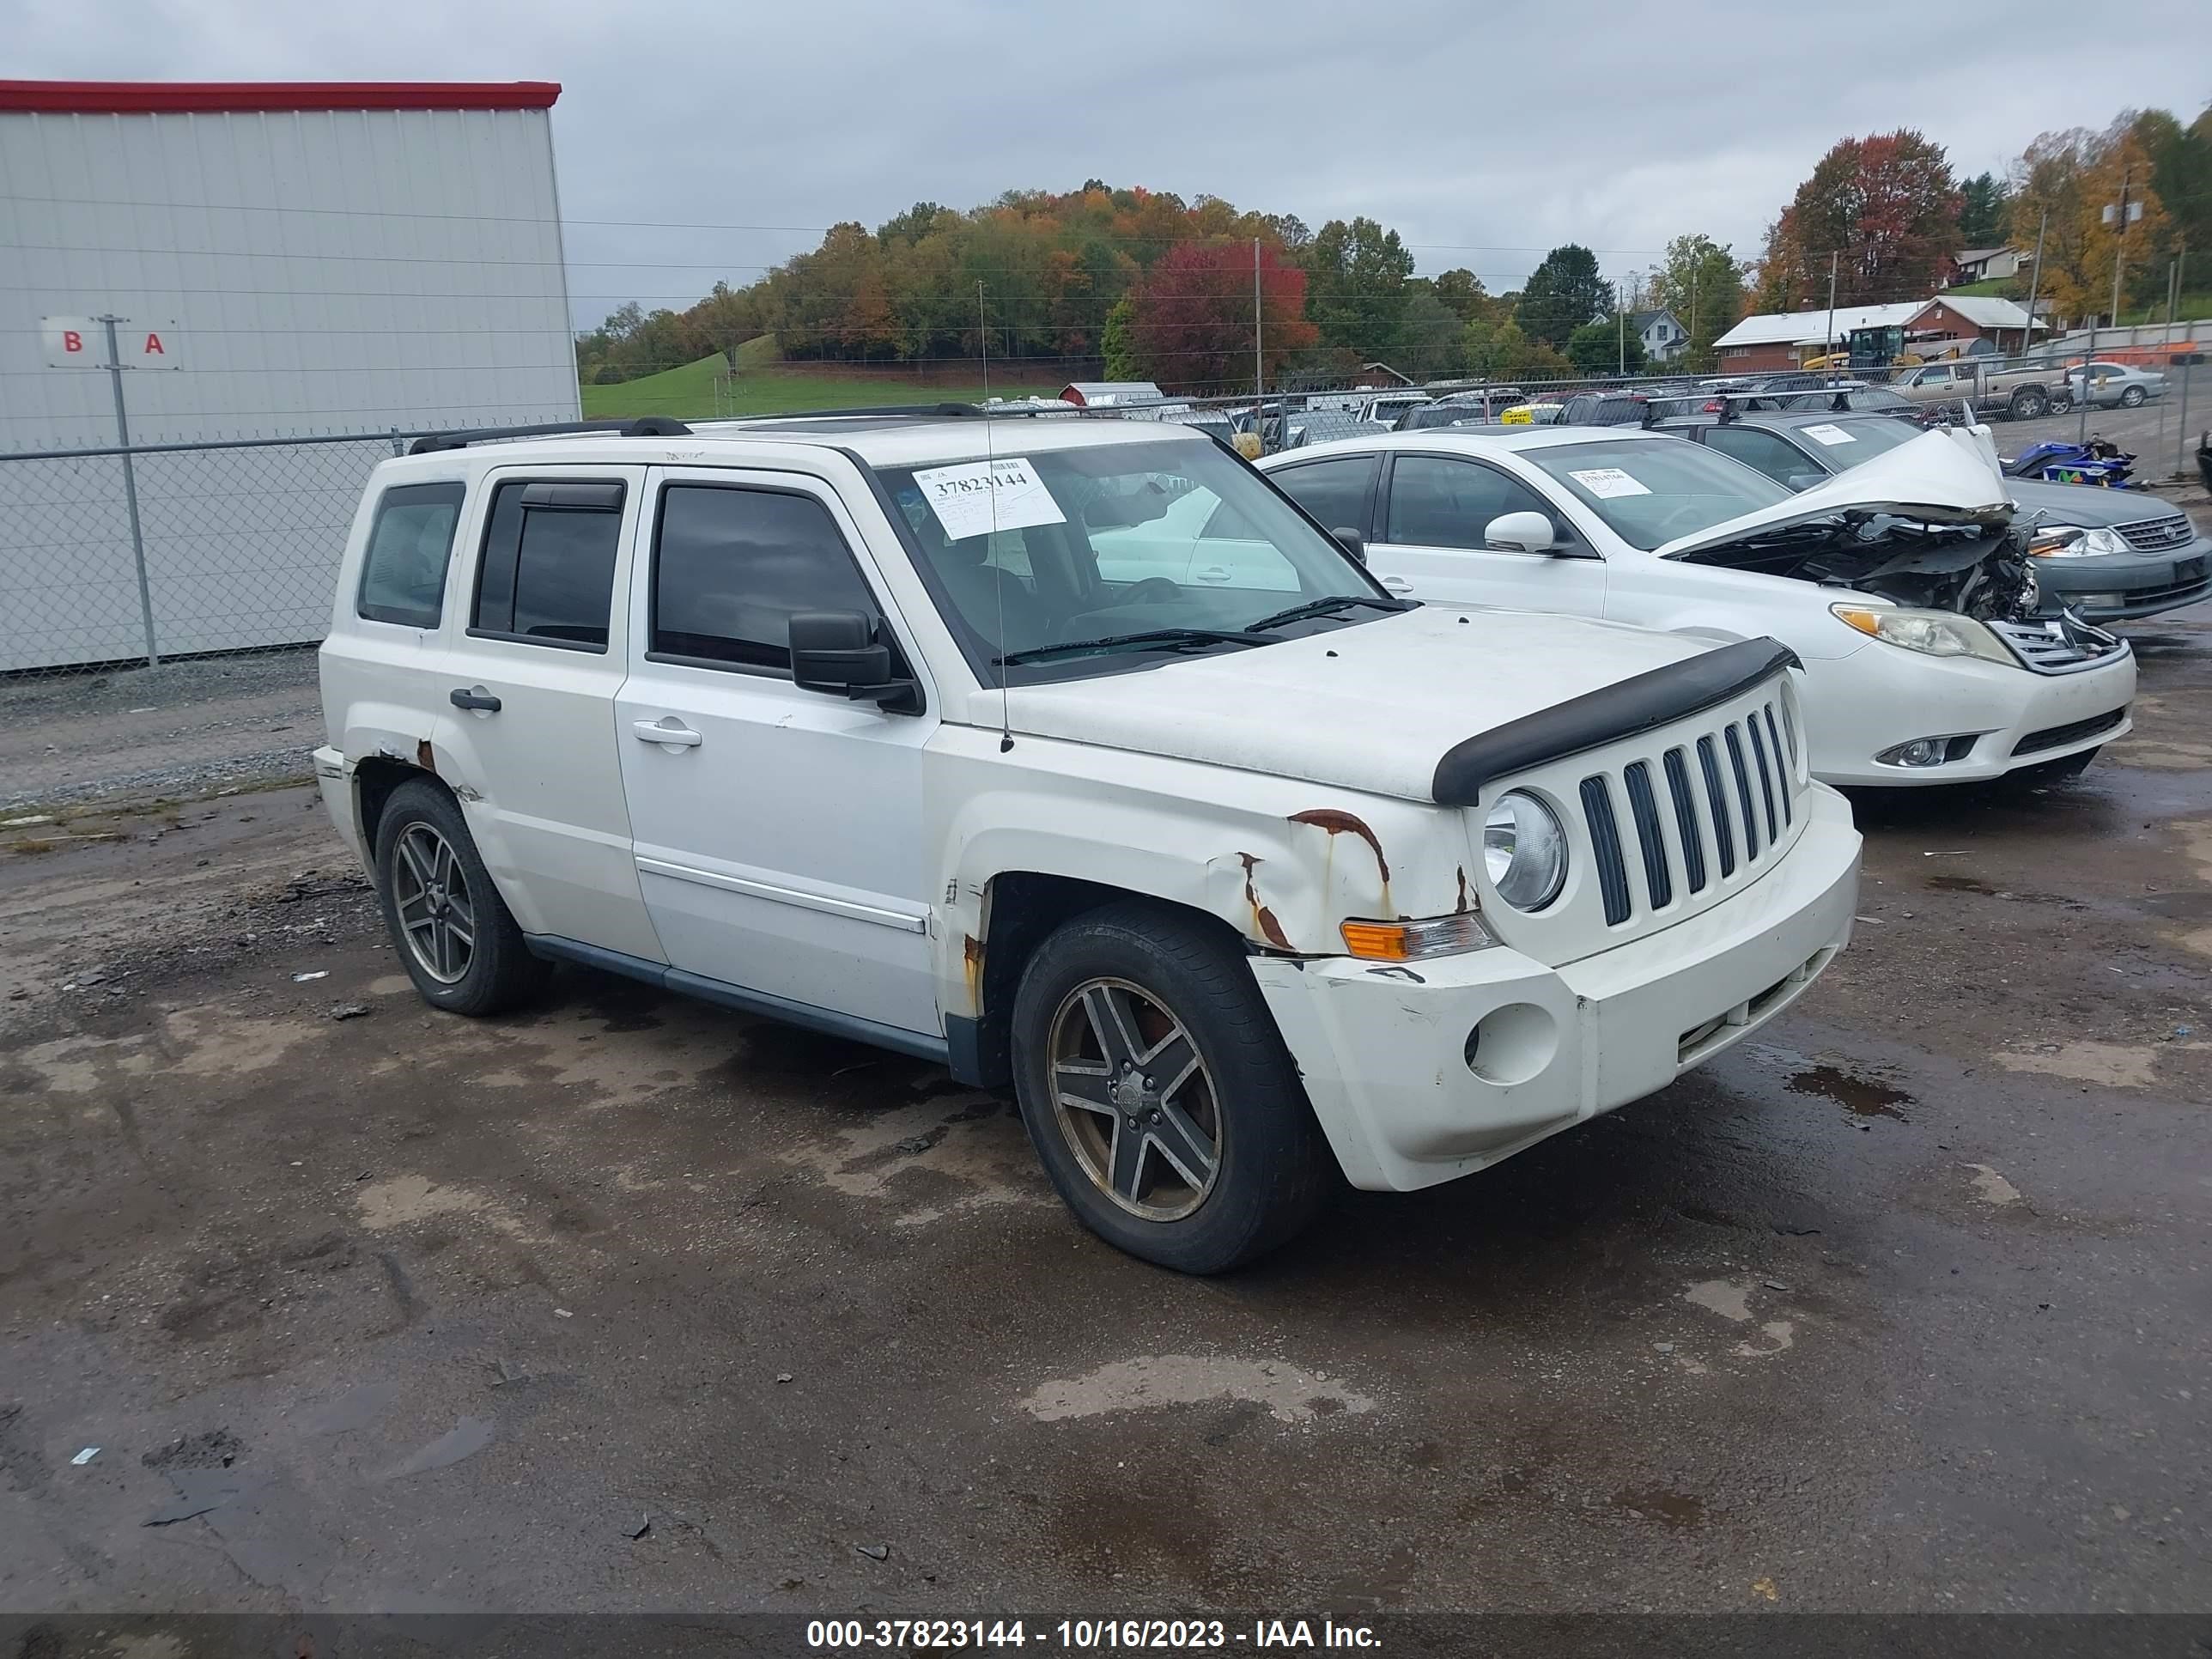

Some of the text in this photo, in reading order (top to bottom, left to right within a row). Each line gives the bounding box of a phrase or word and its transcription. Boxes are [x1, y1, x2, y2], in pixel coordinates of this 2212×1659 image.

[64, 331, 82, 352] B
[145, 333, 165, 354] A
[934, 472, 1027, 496] 37823144
